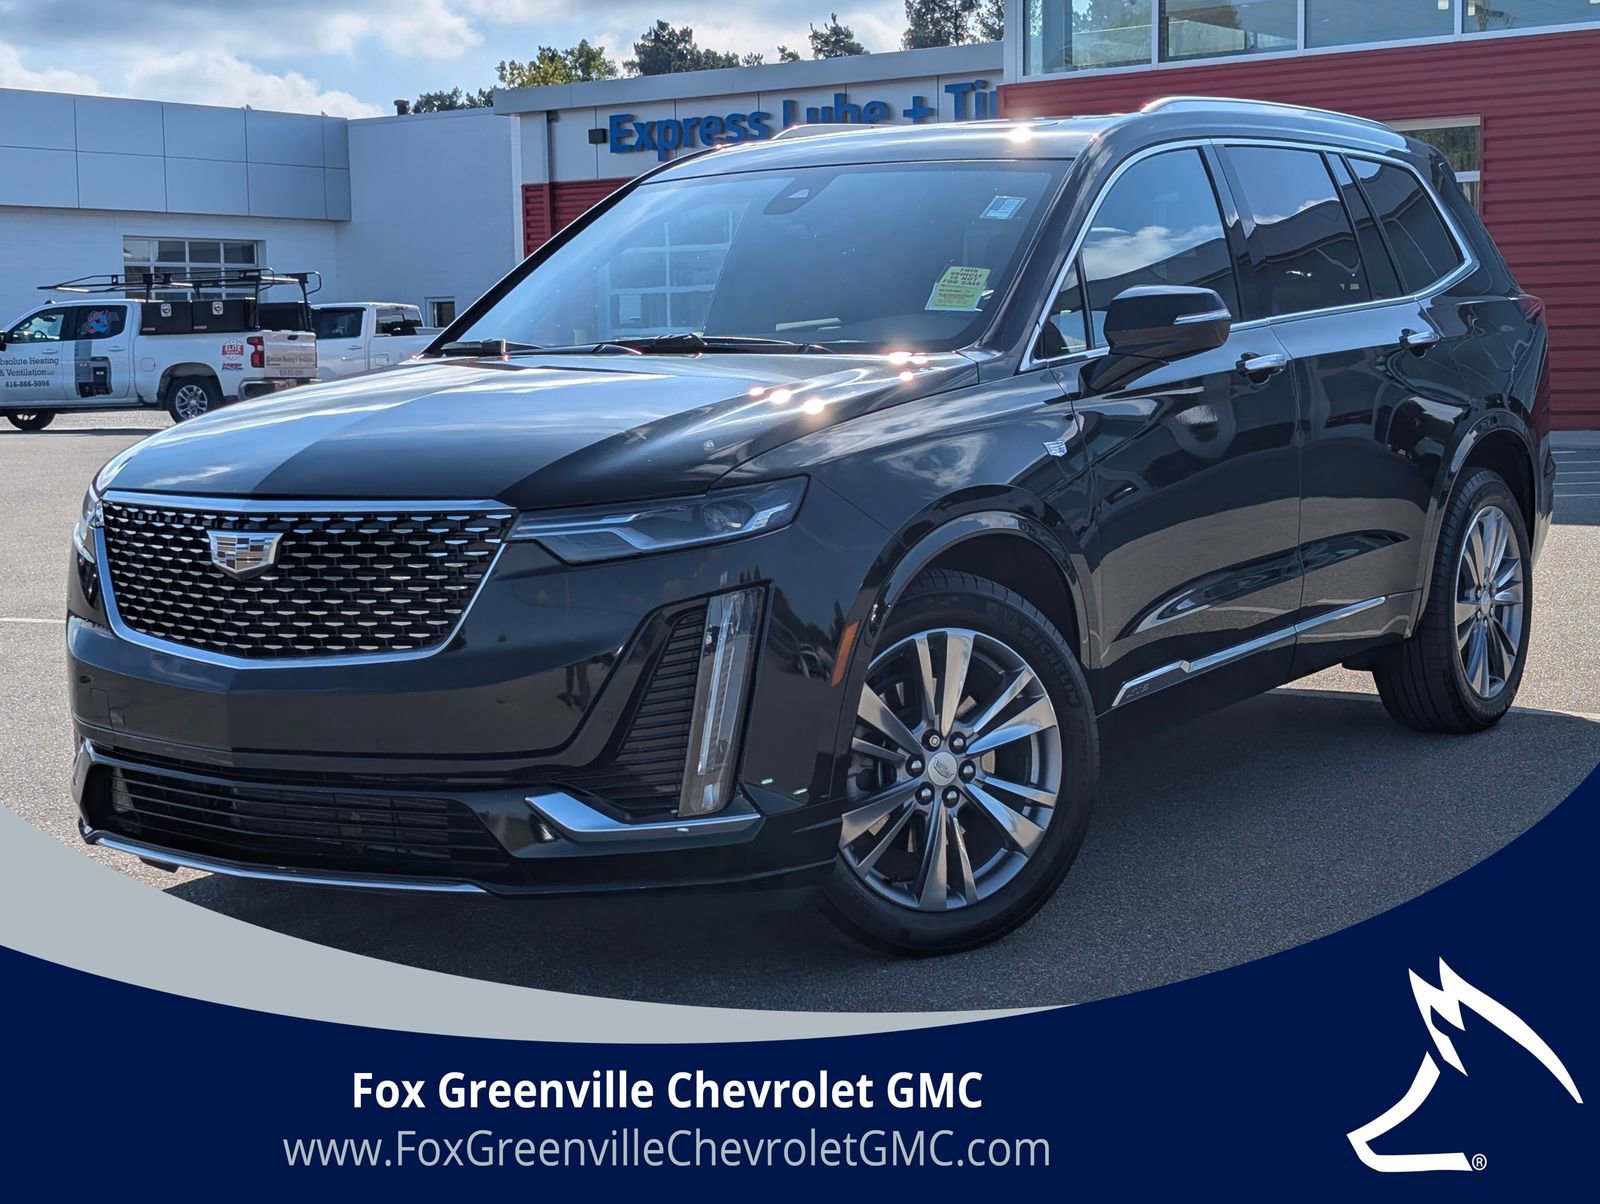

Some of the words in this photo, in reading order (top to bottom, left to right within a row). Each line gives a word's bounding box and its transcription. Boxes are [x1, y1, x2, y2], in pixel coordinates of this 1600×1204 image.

[609, 111, 770, 161] Express
[0, 357, 28, 366] bsolute
[29, 357, 59, 365] Heating
[6, 368, 47, 377] Ventilation
[5, 380, 50, 388] 616-866-5096
[1022, 626, 1079, 707] MICHELIN
